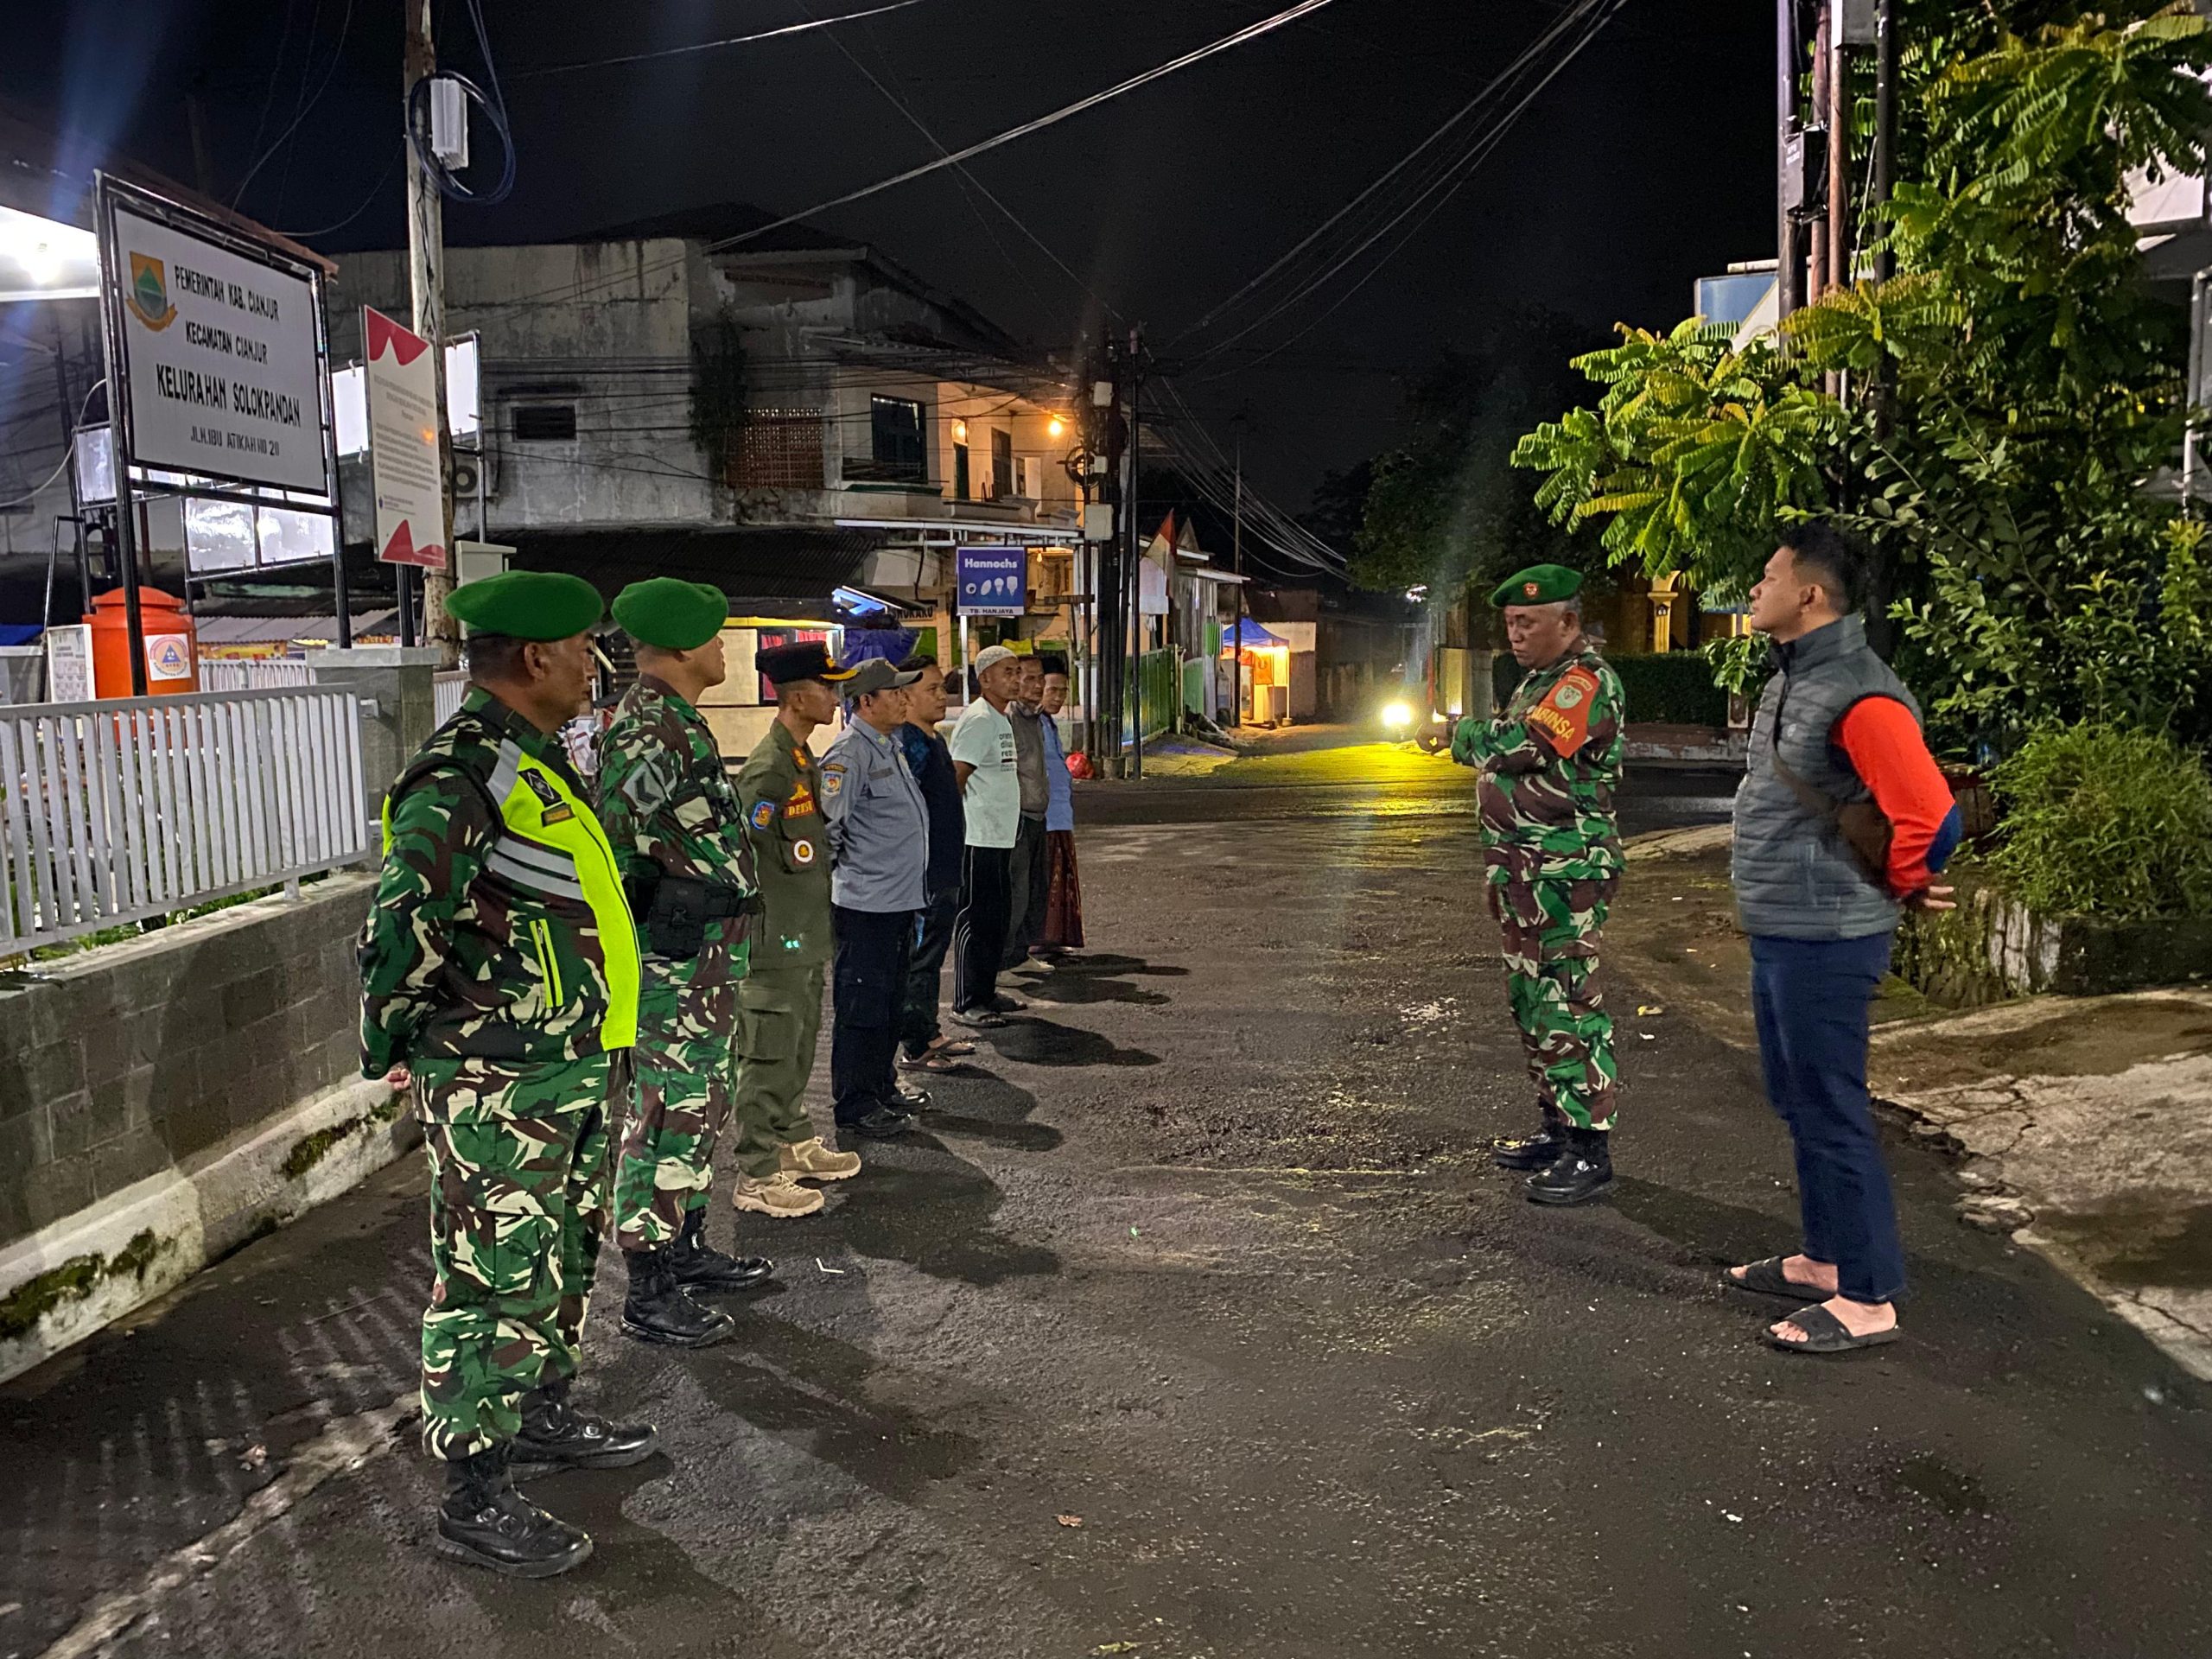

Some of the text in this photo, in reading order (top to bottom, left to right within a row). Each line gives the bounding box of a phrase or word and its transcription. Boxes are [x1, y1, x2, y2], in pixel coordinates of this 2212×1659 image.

[175, 265, 280, 321] PEMERINTAH KAB. CIANJUR
[186, 321, 268, 365] KECAMATAN CIANJUR
[156, 363, 302, 428] KELURAHAN SOLOKPANDAN
[227, 432, 257, 453] ATIKAH
[964, 558, 1018, 569] Hannochs
